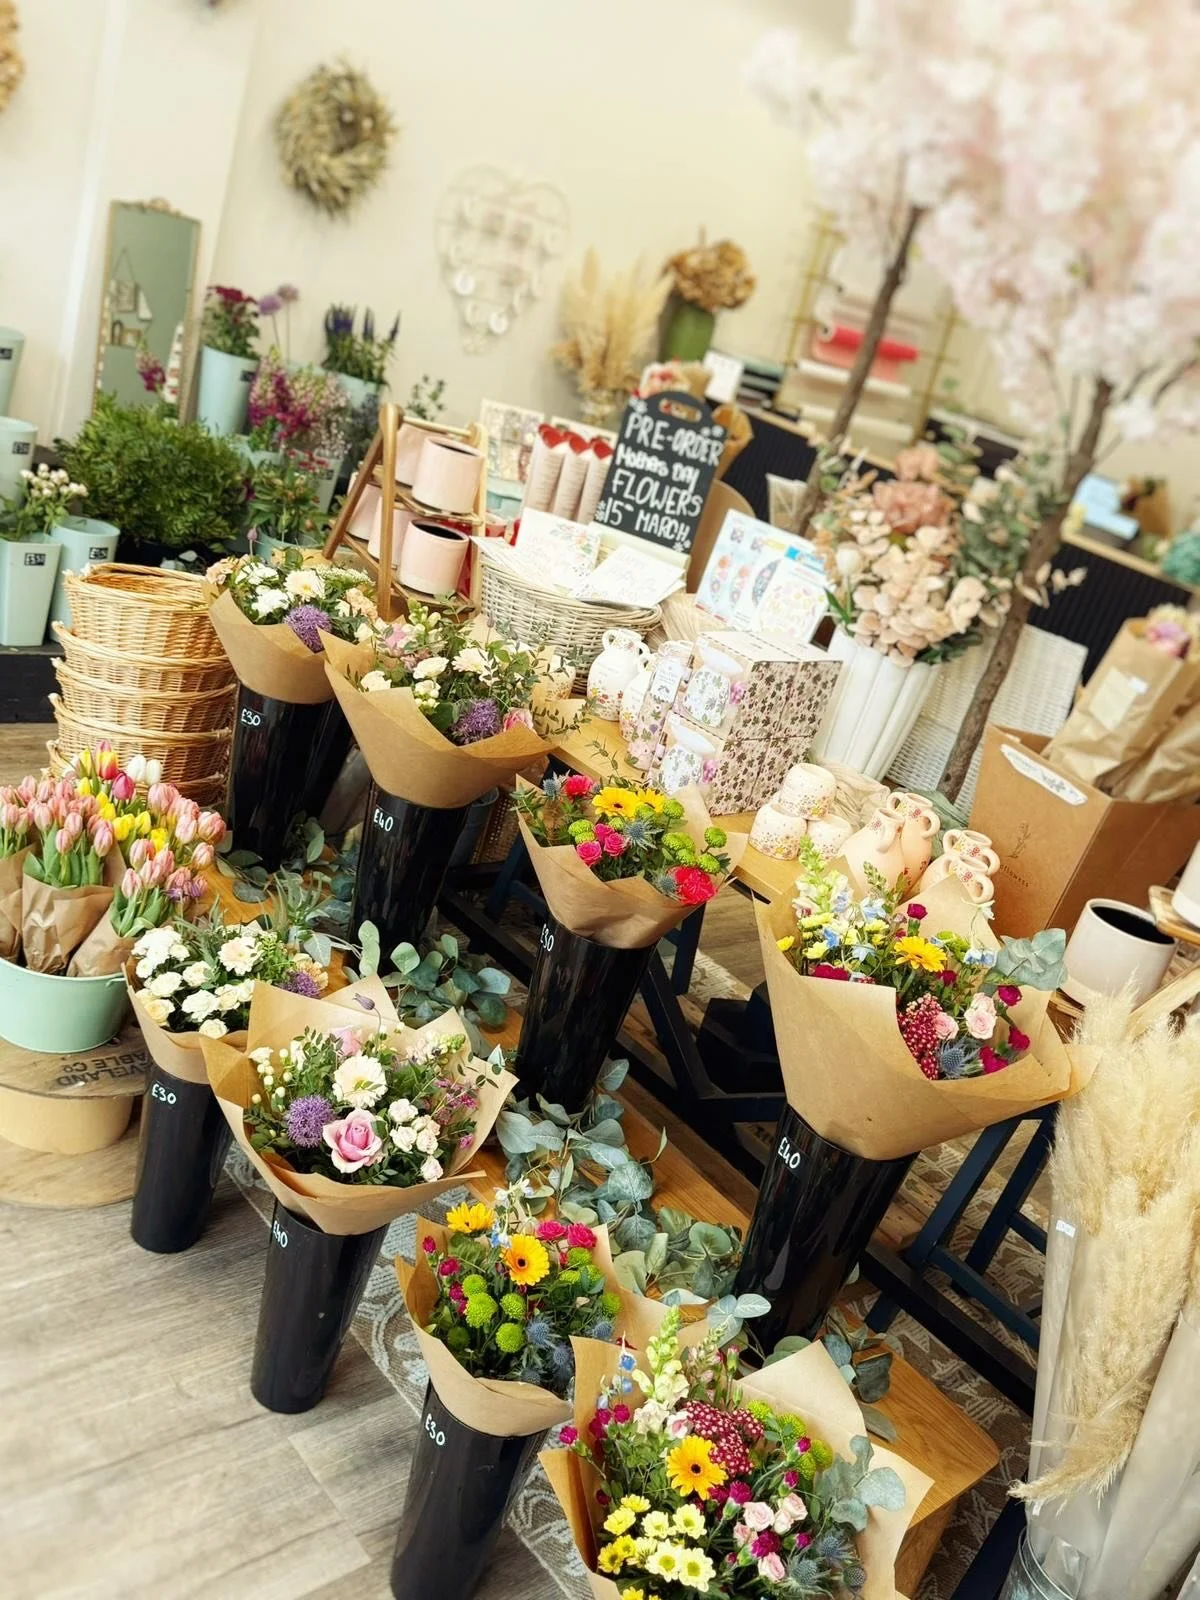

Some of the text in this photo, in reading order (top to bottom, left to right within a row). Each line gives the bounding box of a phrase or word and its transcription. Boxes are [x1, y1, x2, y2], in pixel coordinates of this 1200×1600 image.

[624, 413, 724, 466] PRE-ORDER
[611, 467, 704, 518] FLOWERS
[672, 461, 701, 494] DAY
[635, 508, 691, 542] MARCH
[241, 708, 261, 726] £30
[373, 808, 394, 832] £40
[152, 1083, 177, 1105] £30
[778, 1136, 801, 1169] £40
[425, 1413, 446, 1446] £30
